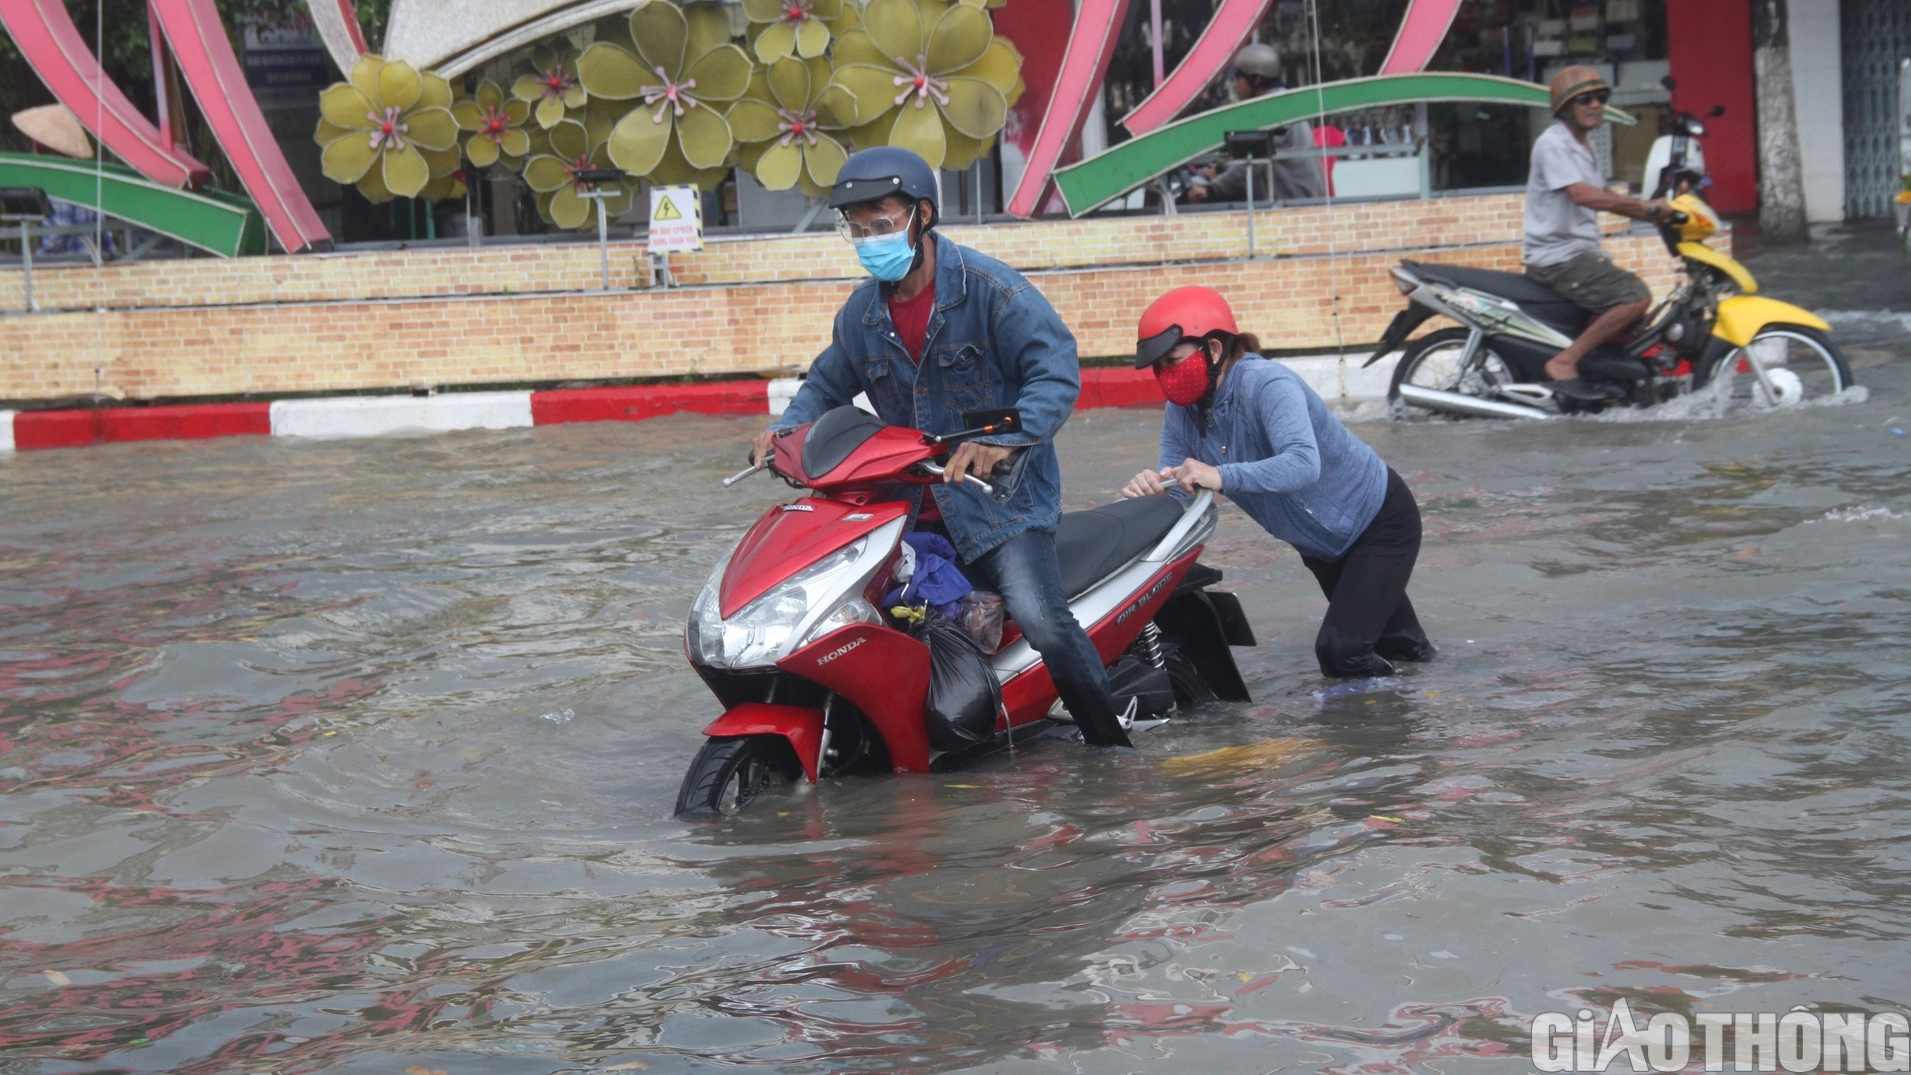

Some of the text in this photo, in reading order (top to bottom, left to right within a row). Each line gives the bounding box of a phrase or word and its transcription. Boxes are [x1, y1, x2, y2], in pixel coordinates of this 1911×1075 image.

[1116, 572, 1173, 624] AIR BLADE
[816, 637, 867, 666] HONDA
